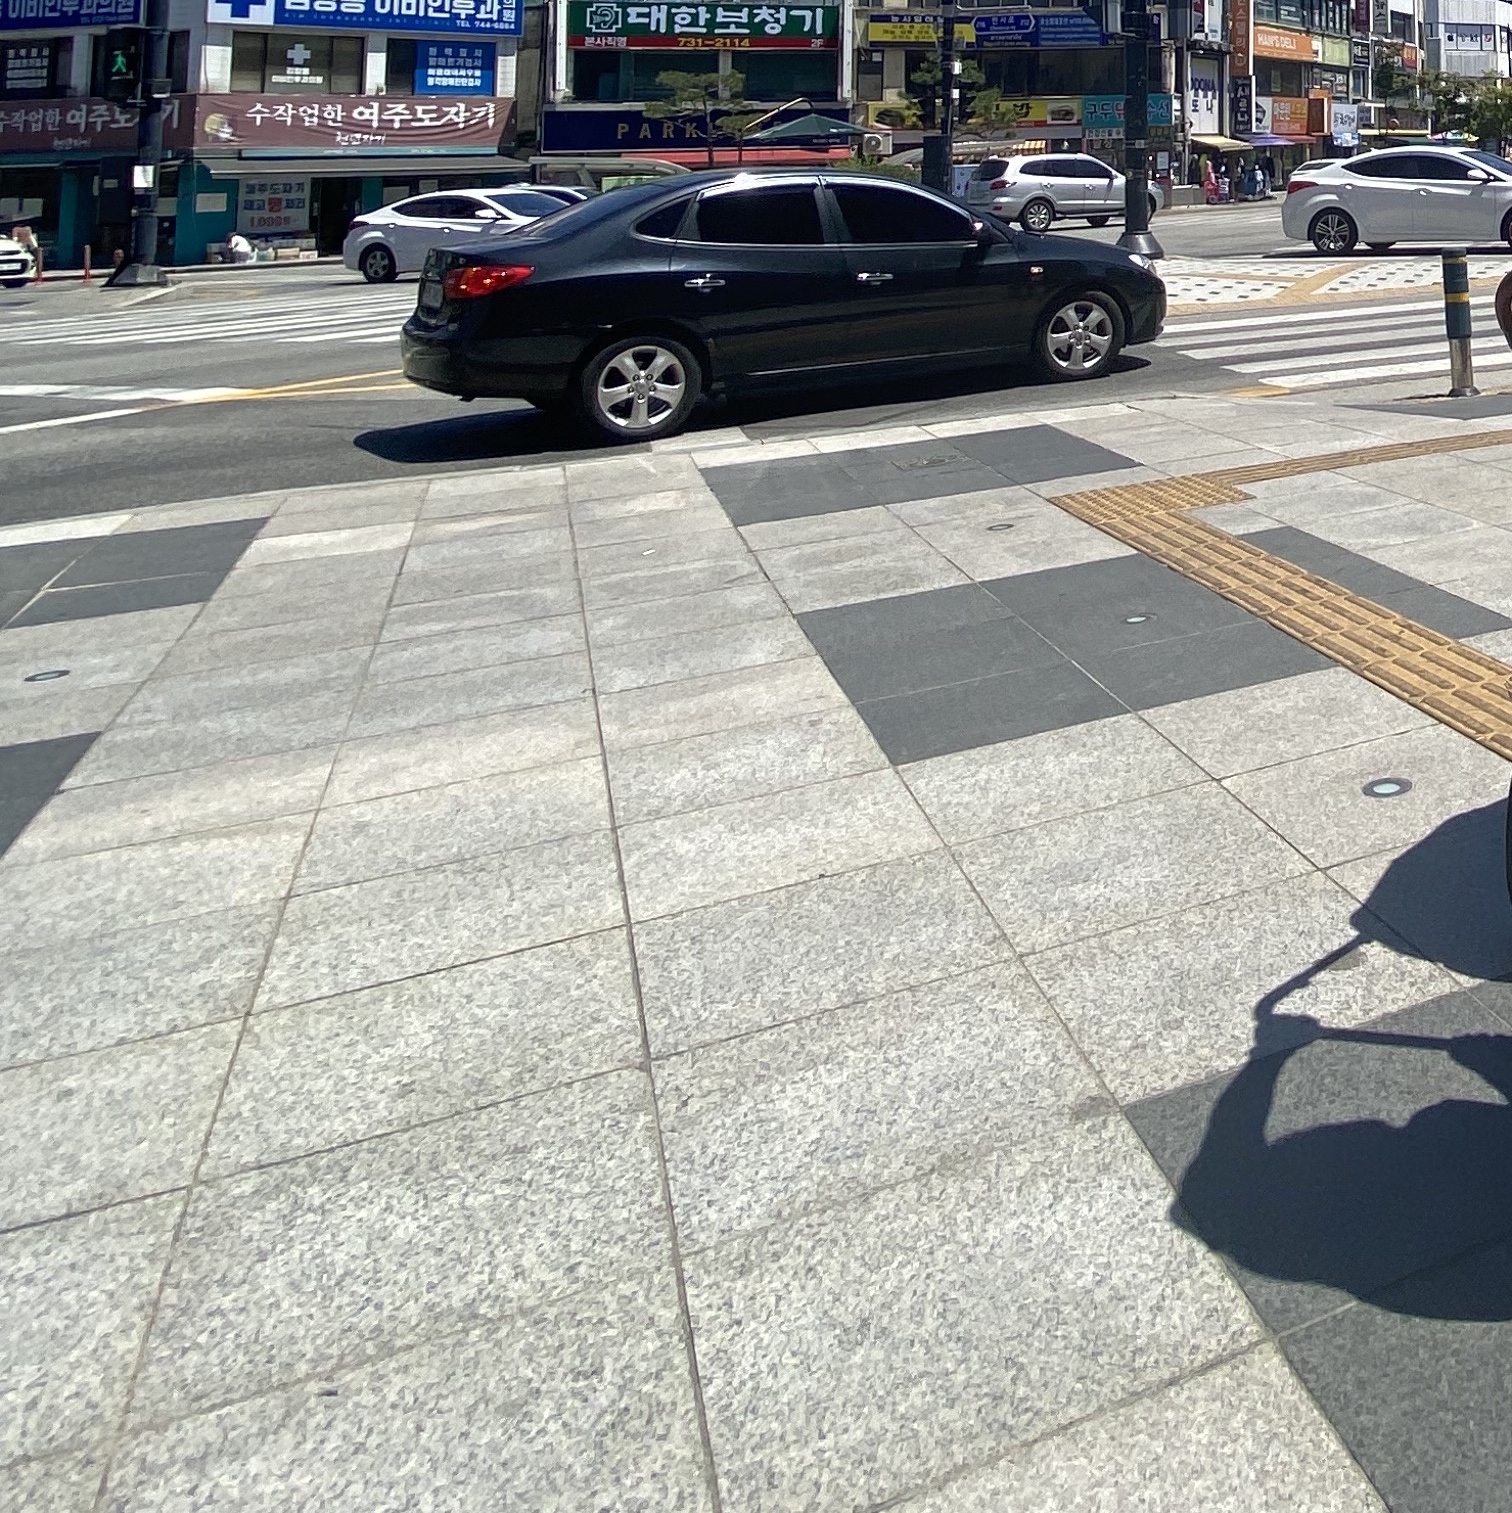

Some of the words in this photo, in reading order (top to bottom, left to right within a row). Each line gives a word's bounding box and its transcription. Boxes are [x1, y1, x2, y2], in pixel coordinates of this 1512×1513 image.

[456, 20, 471, 28] TEL
[626, 5, 825, 36] 대한보청기
[246, 102, 346, 126] 수작업한
[352, 101, 495, 129] 여주도자기
